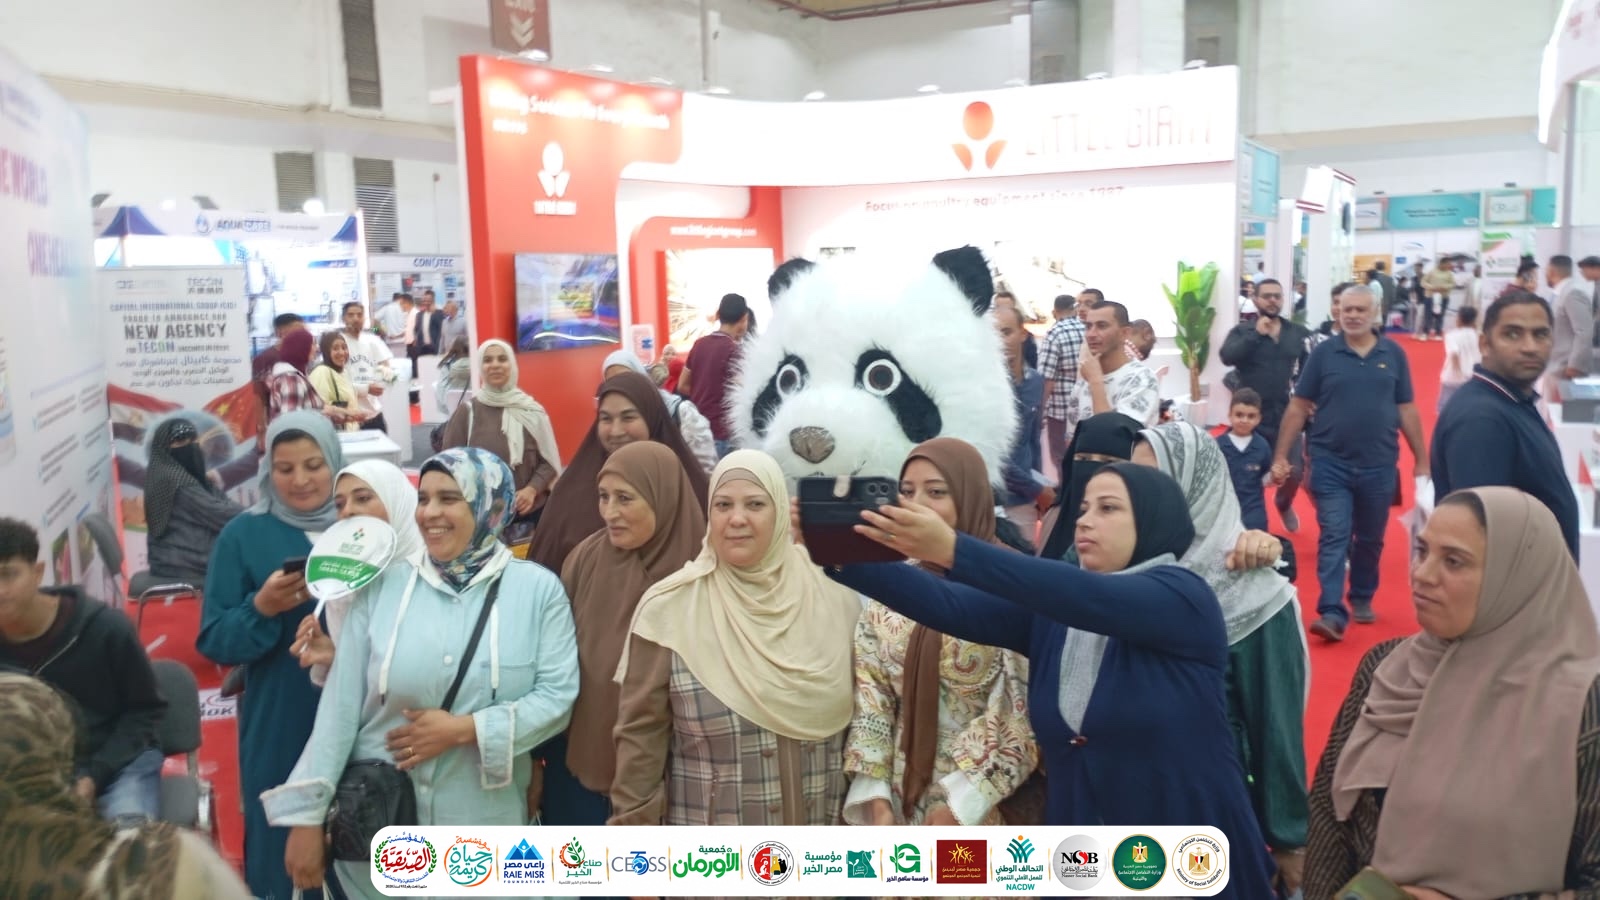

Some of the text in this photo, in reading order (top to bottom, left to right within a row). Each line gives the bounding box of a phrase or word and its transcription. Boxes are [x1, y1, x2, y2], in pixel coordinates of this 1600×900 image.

[124, 323, 227, 340] NEW AGENCY
[137, 341, 175, 354] TECON
